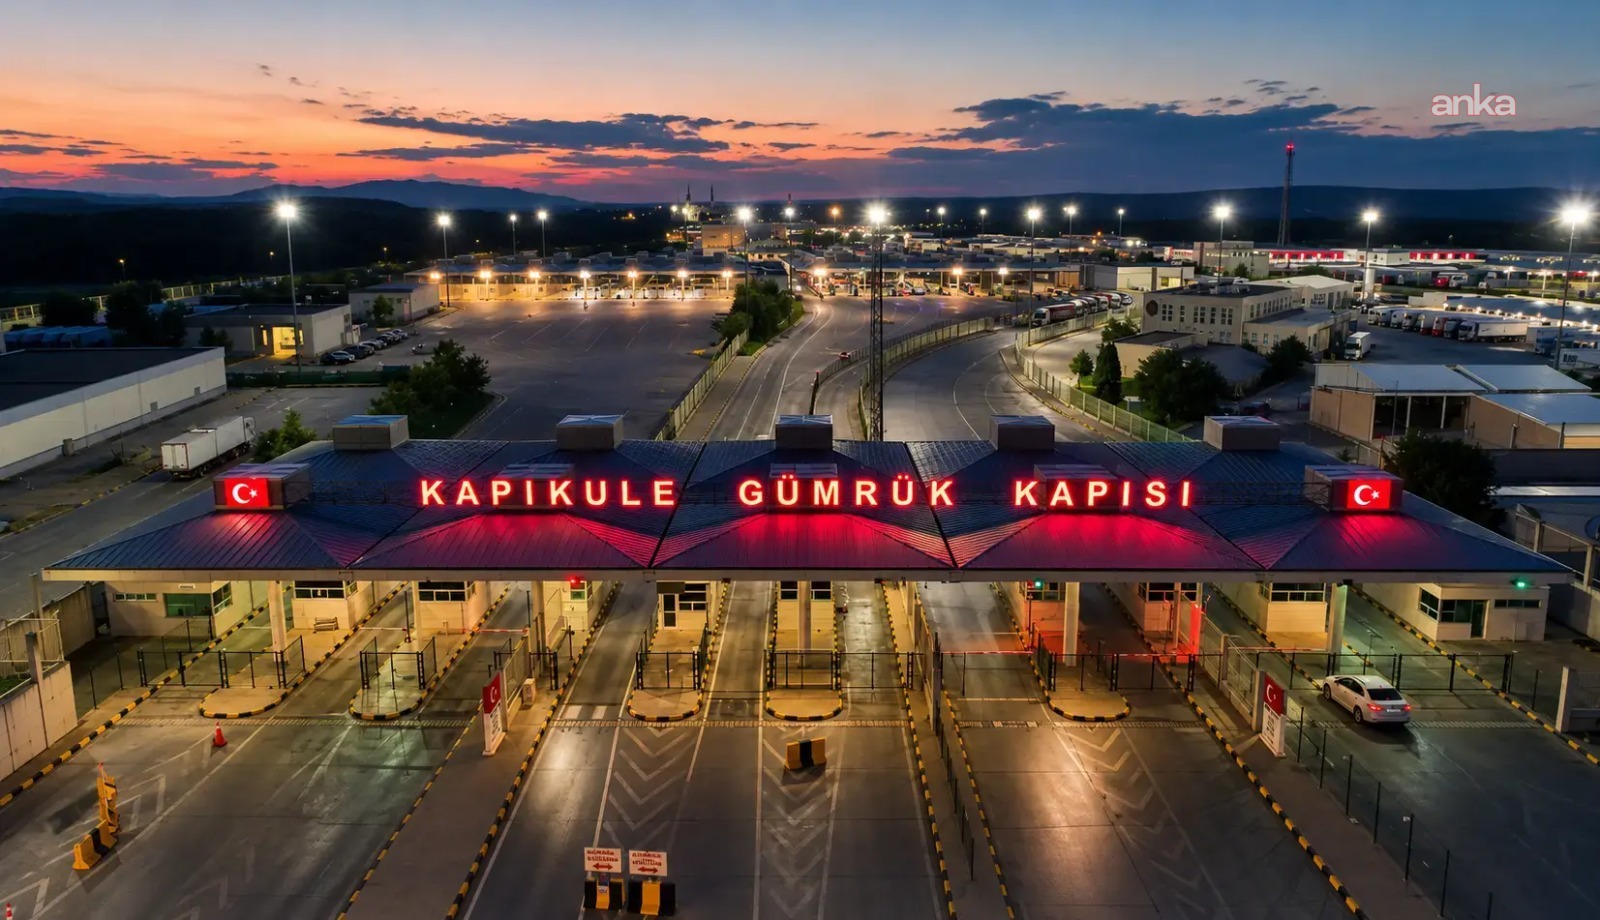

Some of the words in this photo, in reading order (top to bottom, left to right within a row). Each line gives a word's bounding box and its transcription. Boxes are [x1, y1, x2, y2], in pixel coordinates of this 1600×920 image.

[420, 480, 675, 506] KAPIKULE
[738, 474, 954, 506] GÜMRÜK
[1014, 480, 1191, 507] KAPISI
